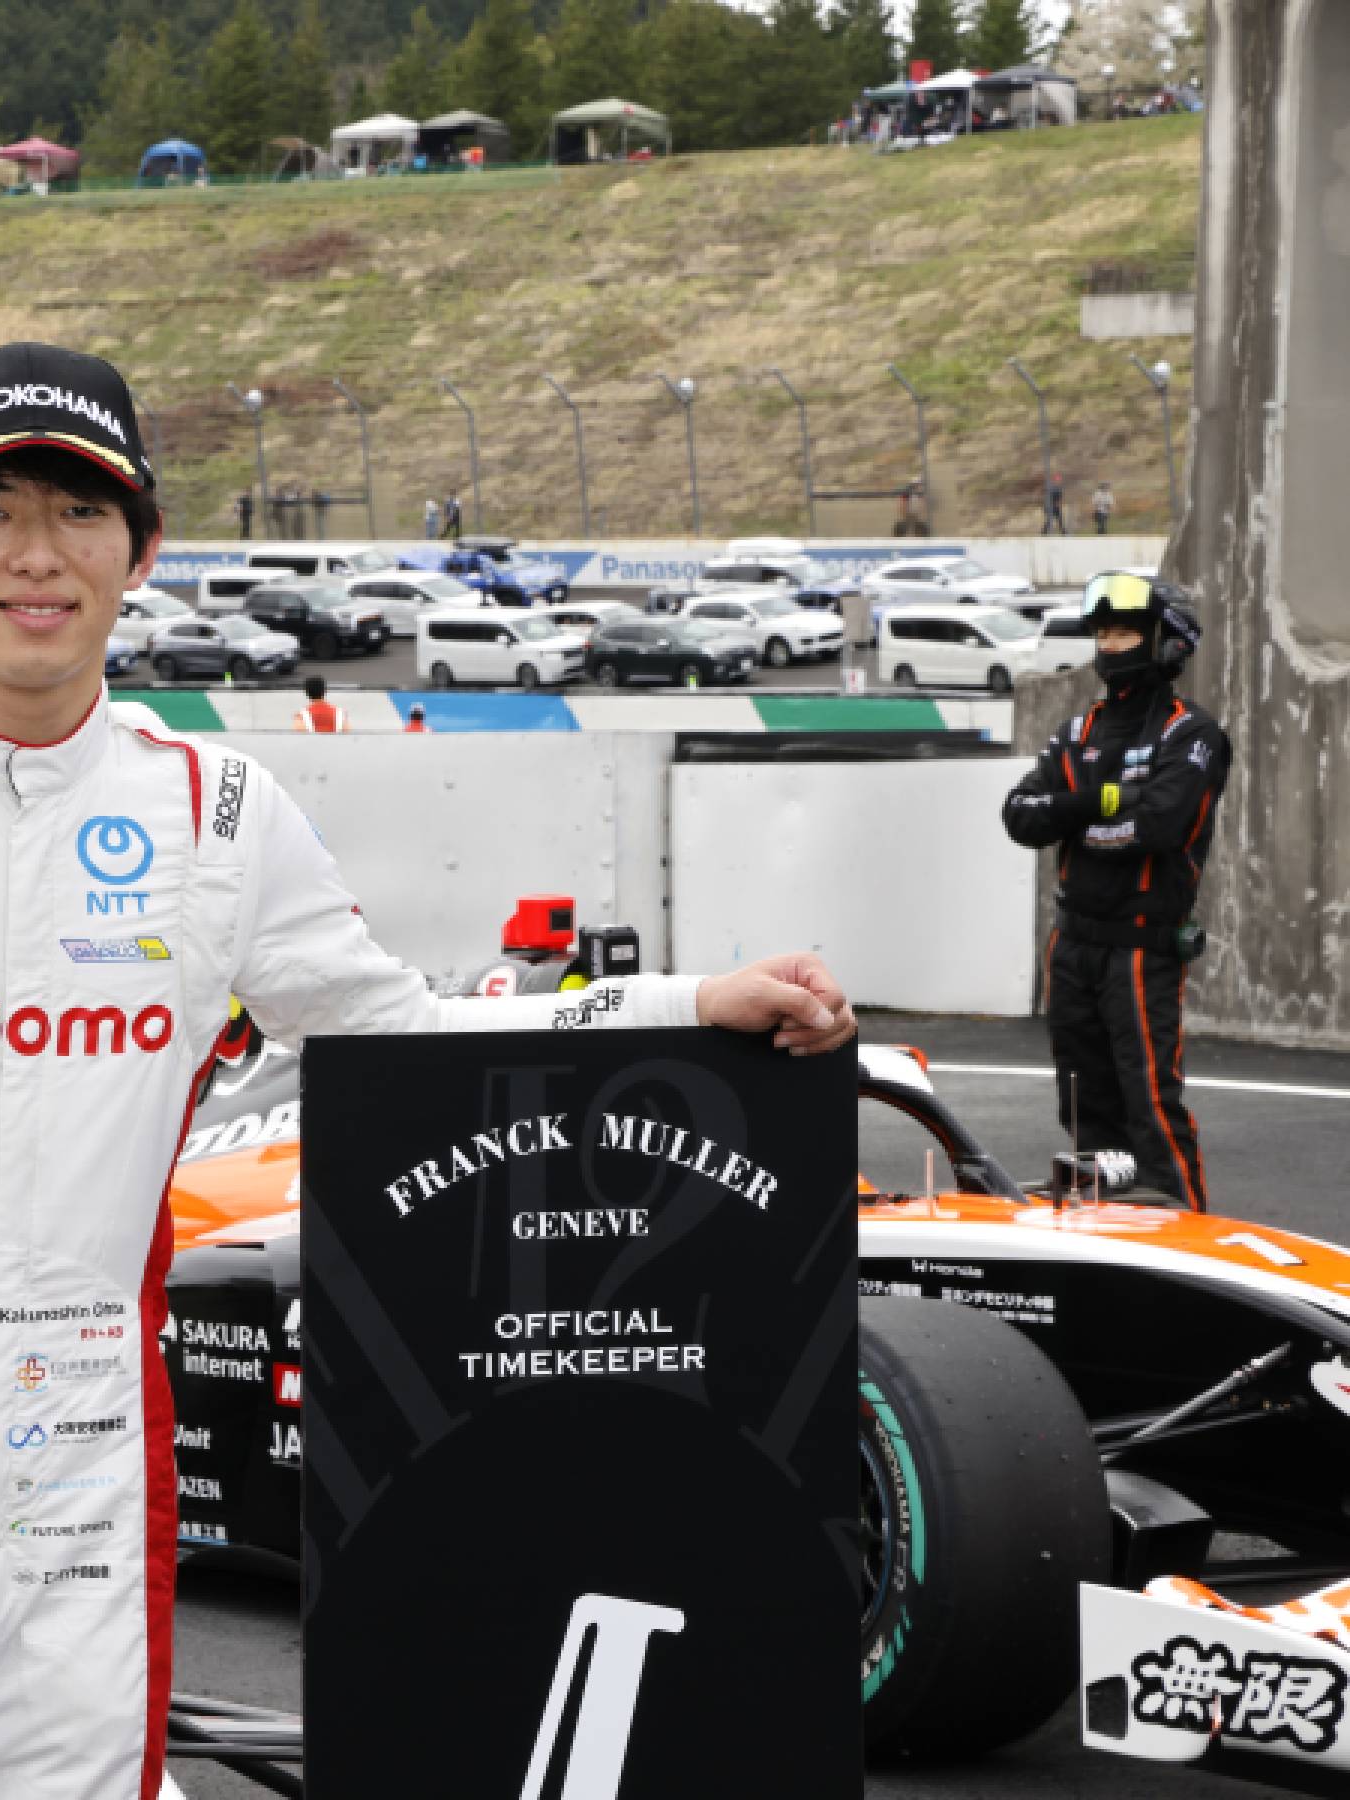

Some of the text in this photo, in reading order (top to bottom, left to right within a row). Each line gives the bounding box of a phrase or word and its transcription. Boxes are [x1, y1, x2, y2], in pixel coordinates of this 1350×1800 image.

[86, 891, 150, 916] NTT
[383, 1111, 779, 1219] FRANCK MULLER
[512, 1207, 650, 1240] GENEVE
[181, 1318, 271, 1353] SAKURA
[494, 1307, 674, 1339] OFFICIAL
[182, 1348, 265, 1382] internet
[458, 1344, 707, 1379] TIMEKEEPER
[1134, 1637, 1346, 1751] 無限
